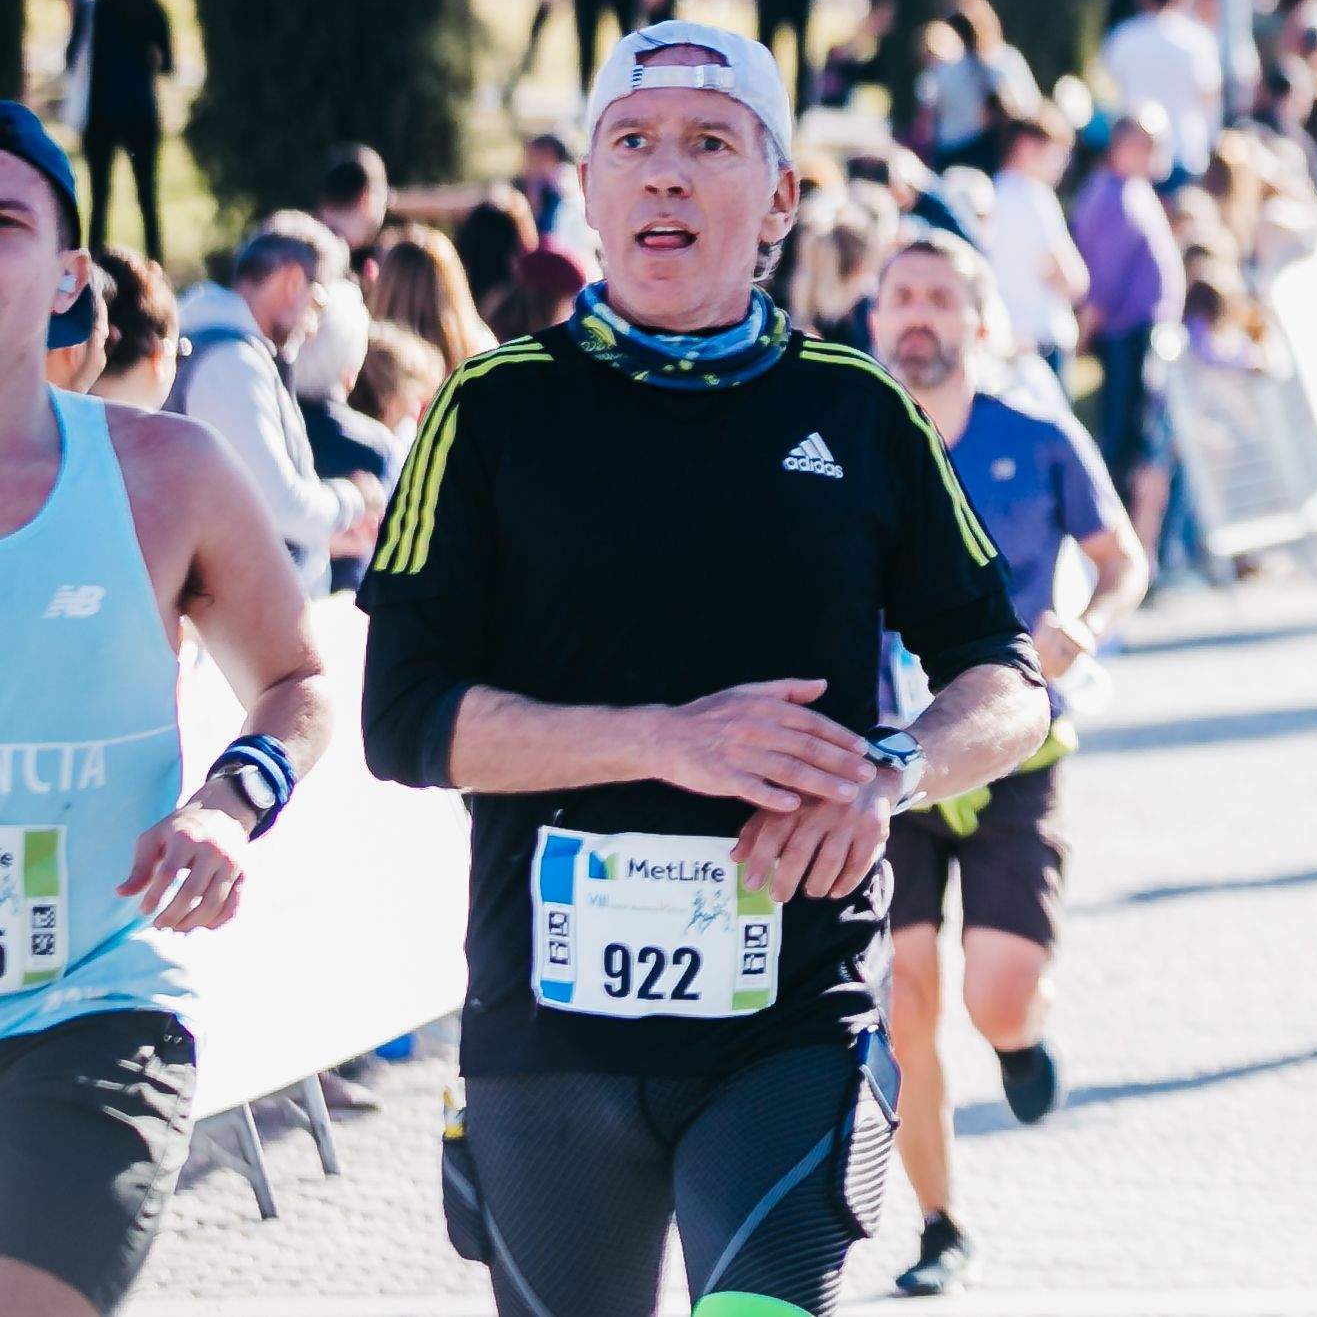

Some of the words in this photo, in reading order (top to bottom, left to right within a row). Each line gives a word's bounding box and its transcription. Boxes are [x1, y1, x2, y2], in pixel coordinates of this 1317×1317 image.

[782, 455, 844, 479] adidas
[627, 857, 727, 883] MetLife
[603, 942, 702, 1001] 922
